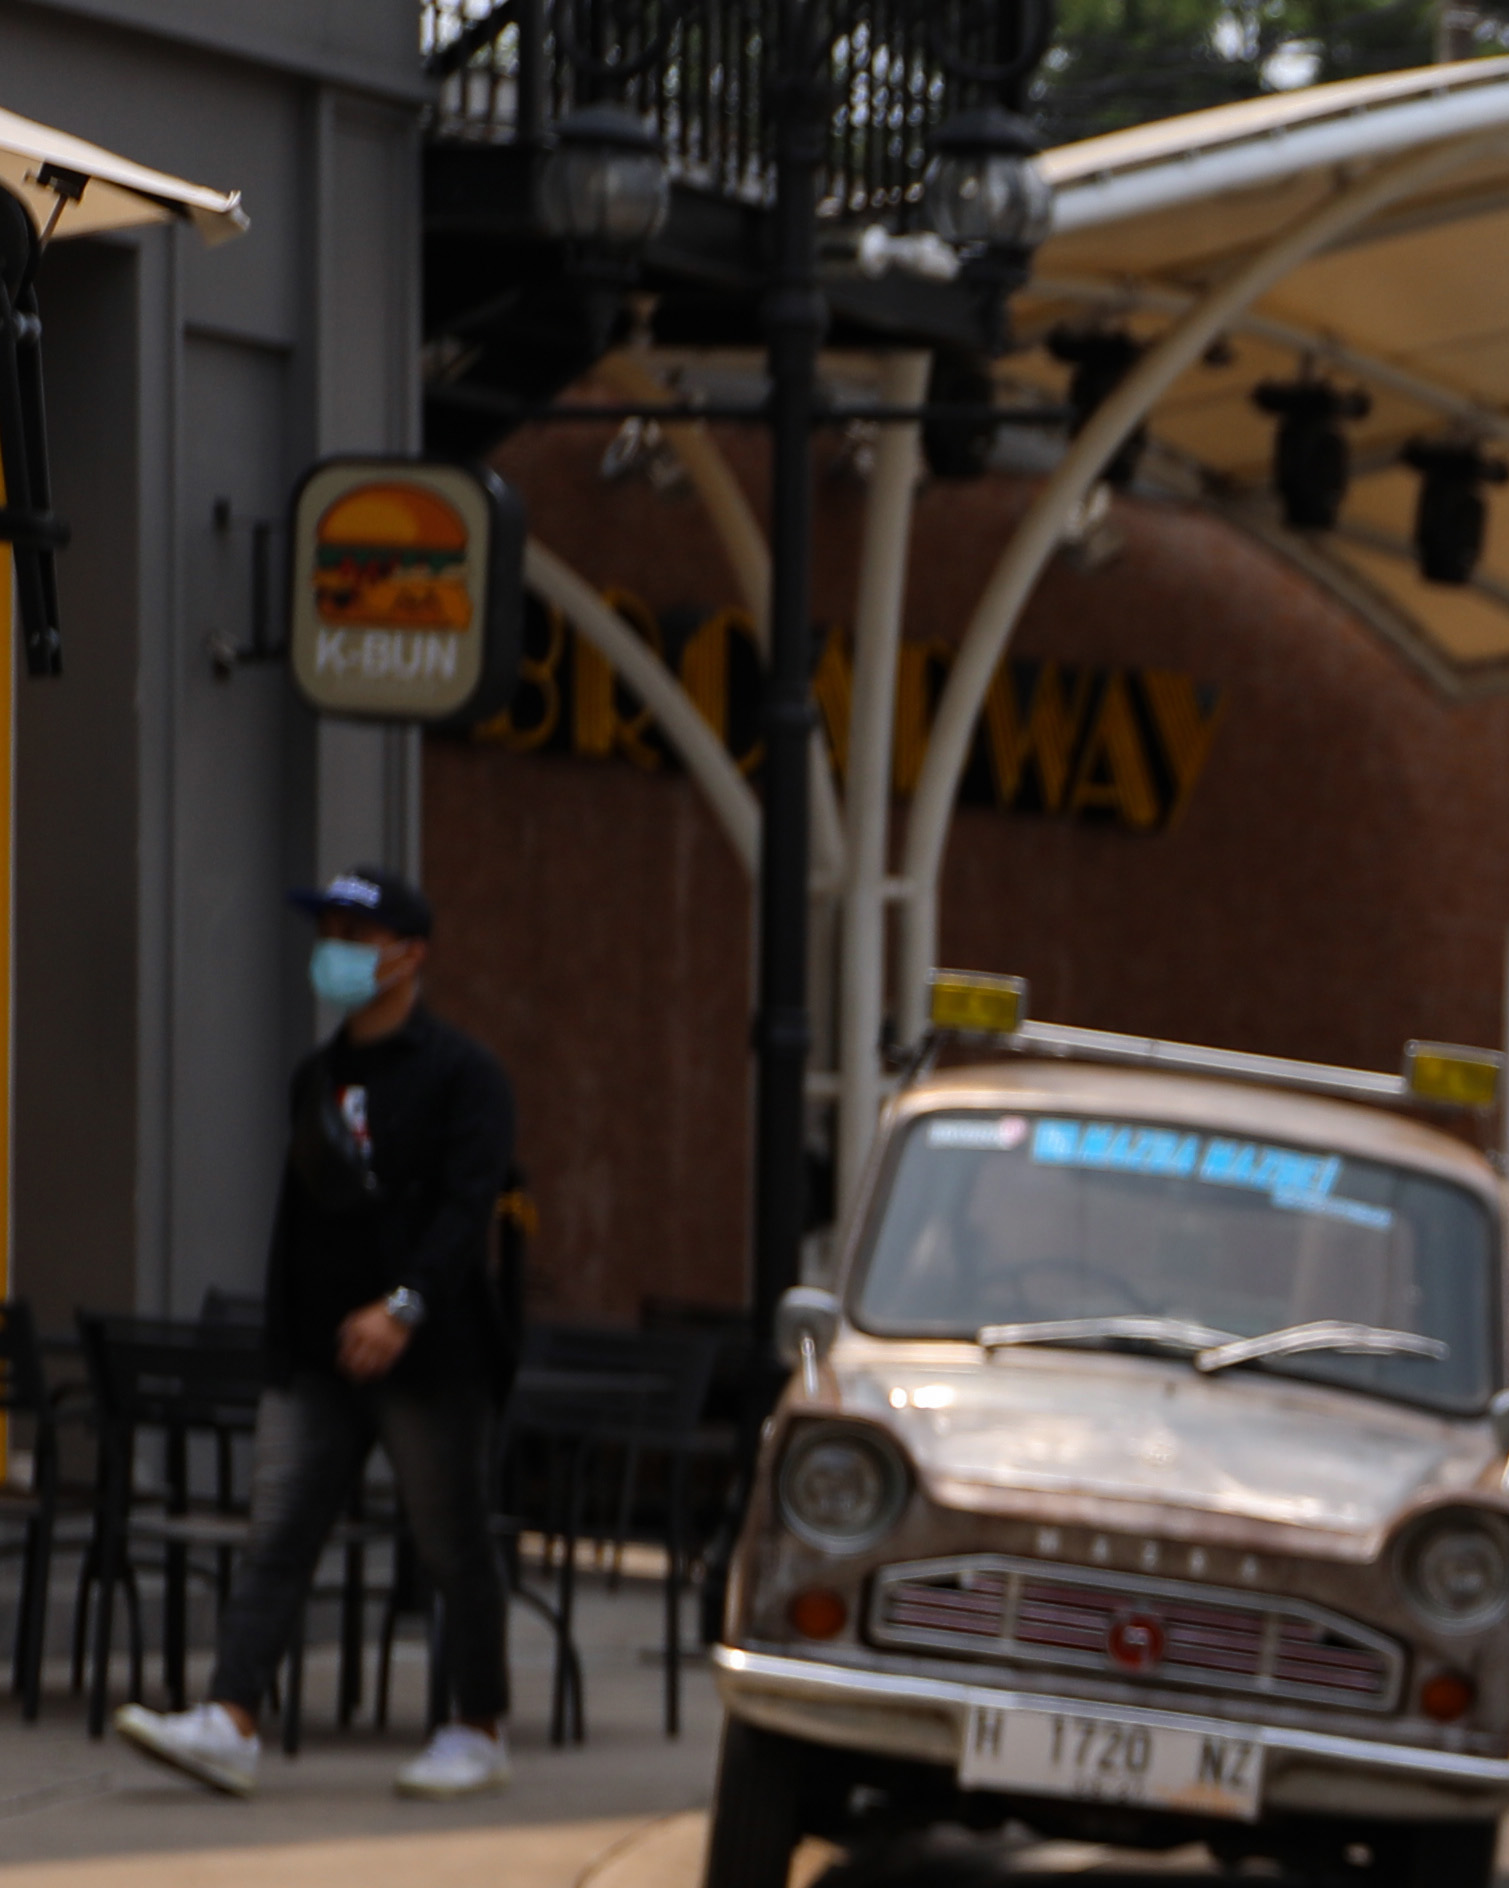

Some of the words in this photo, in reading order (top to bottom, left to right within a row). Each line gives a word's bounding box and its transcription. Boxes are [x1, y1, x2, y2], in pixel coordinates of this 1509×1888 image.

[315, 629, 457, 680] K-BUN
[974, 1704, 1003, 1763] H
[1052, 1713, 1152, 1776] 1720
[1199, 1735, 1252, 1787] NZ
